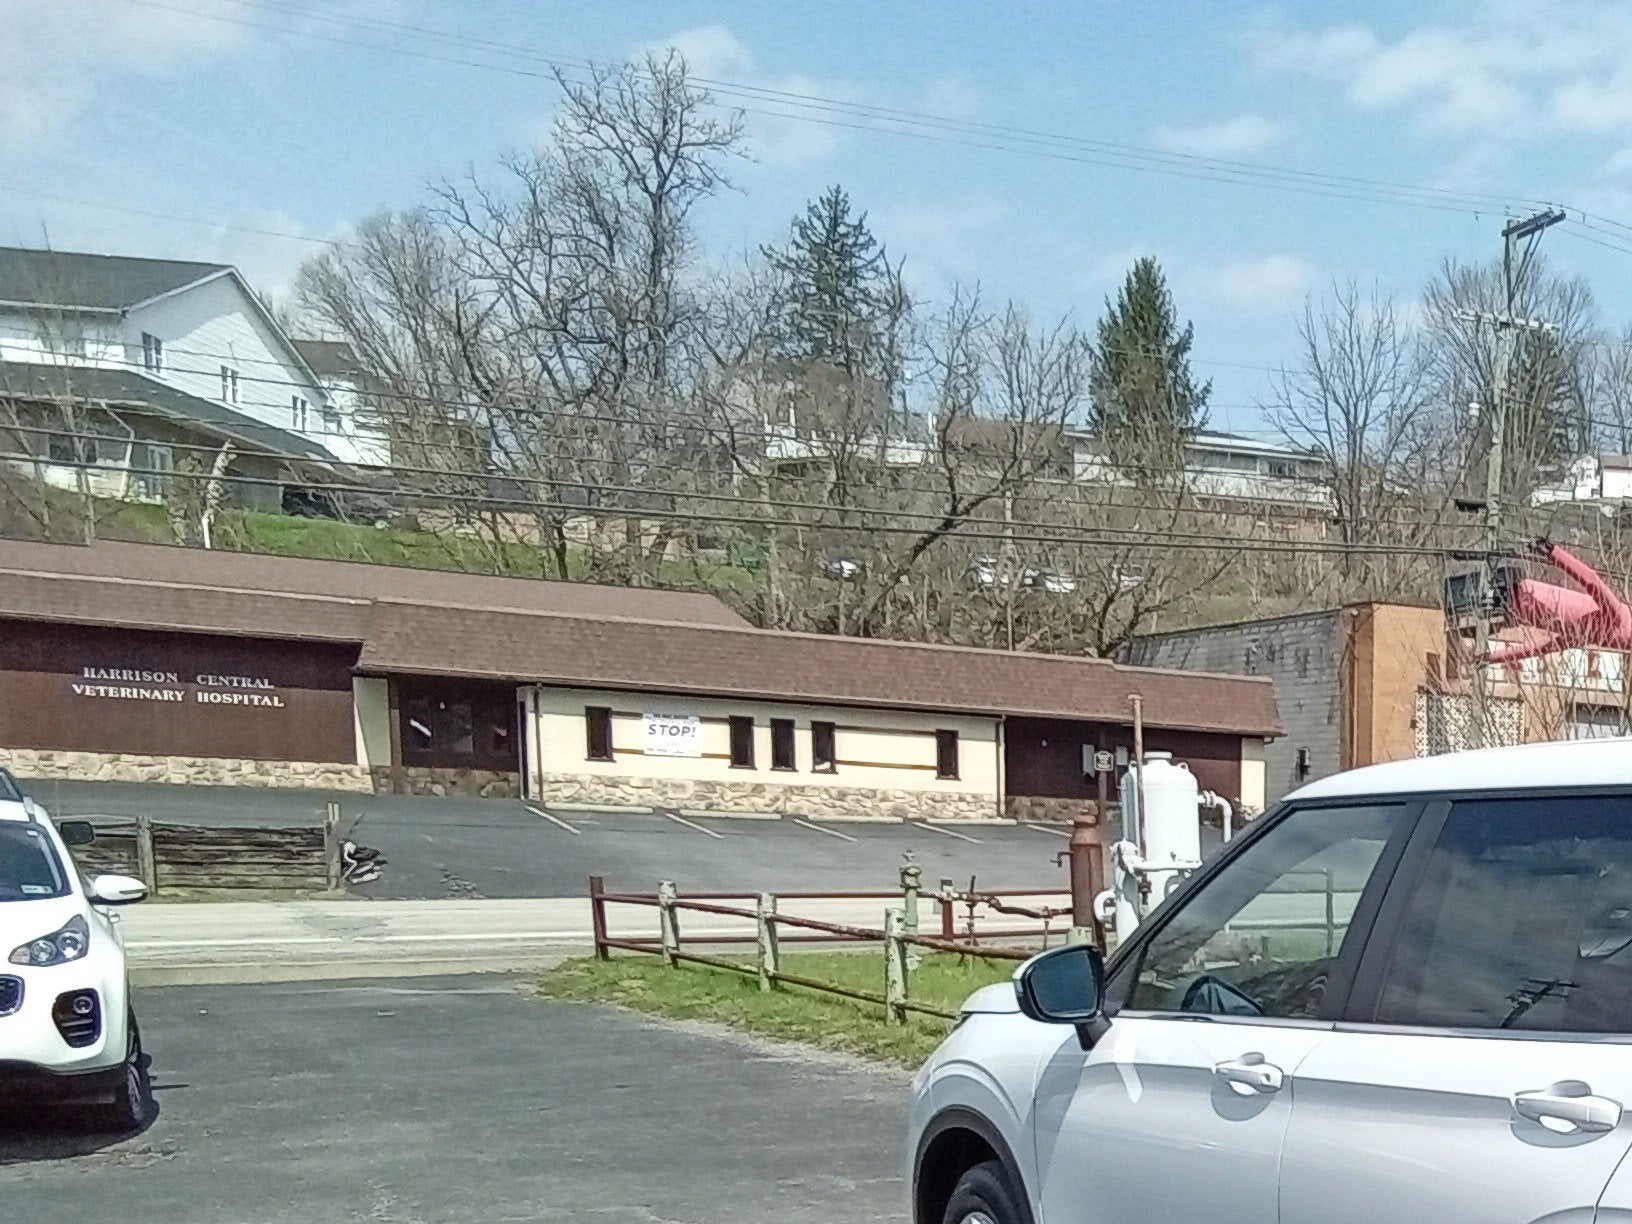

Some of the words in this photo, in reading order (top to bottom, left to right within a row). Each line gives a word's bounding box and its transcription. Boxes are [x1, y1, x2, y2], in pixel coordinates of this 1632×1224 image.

[83, 667, 179, 684] HARRISON
[196, 674, 275, 690] CENTRAL
[71, 684, 186, 703] VETERINARY
[196, 692, 285, 708] HOSPITAL
[648, 723, 697, 738] STOP!
